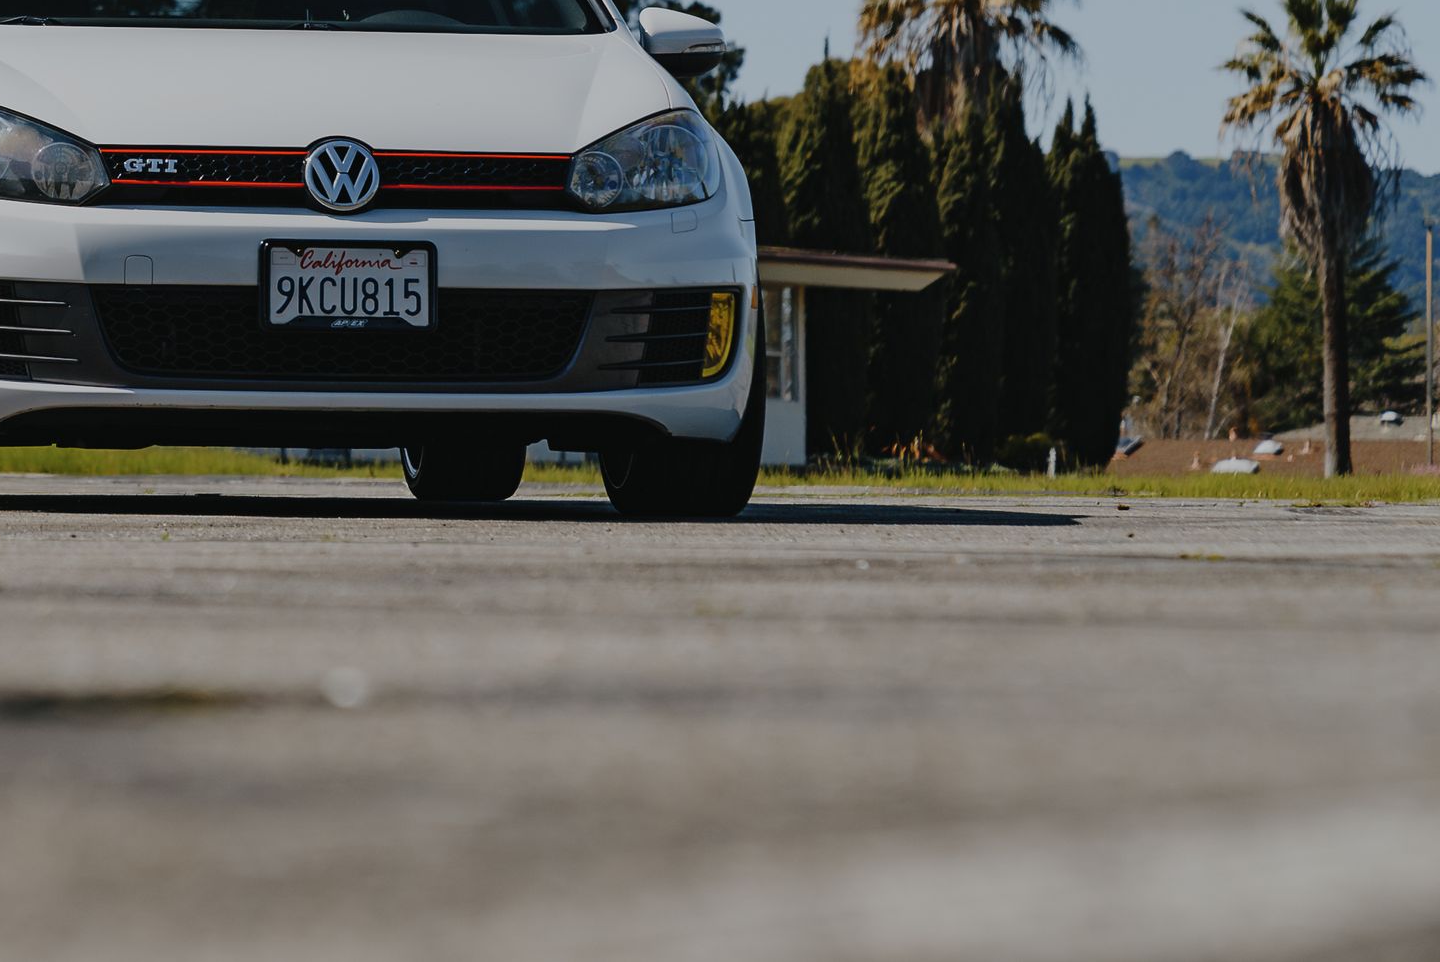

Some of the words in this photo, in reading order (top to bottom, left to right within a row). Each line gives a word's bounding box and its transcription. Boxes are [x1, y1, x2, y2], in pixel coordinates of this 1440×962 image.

[123, 158, 178, 174] GTI
[299, 250, 403, 276] California
[275, 276, 422, 317] 9KCU815
